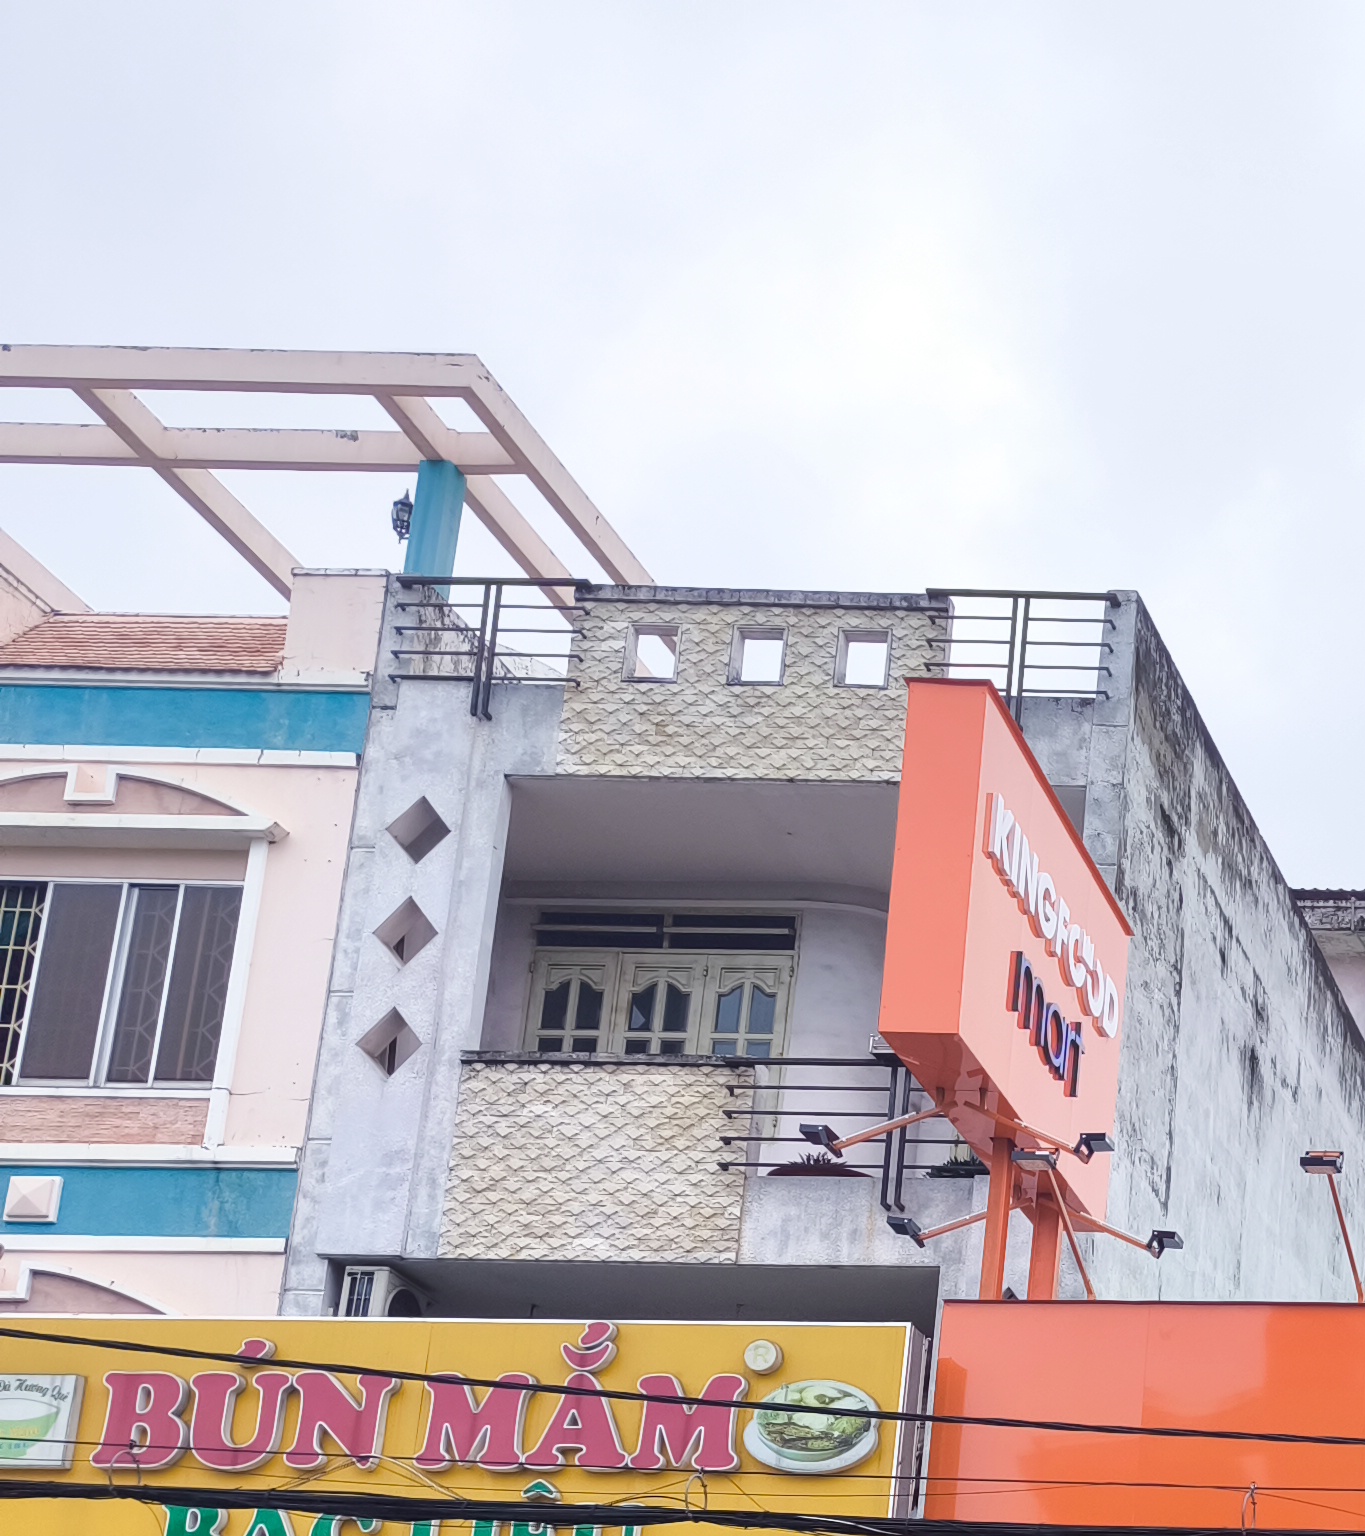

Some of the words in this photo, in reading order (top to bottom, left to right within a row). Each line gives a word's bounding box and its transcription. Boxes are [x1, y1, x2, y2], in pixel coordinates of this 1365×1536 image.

[1006, 950, 1087, 1097] mart
[89, 1338, 398, 1472] BÚN
[408, 1321, 749, 1473] MẮM
